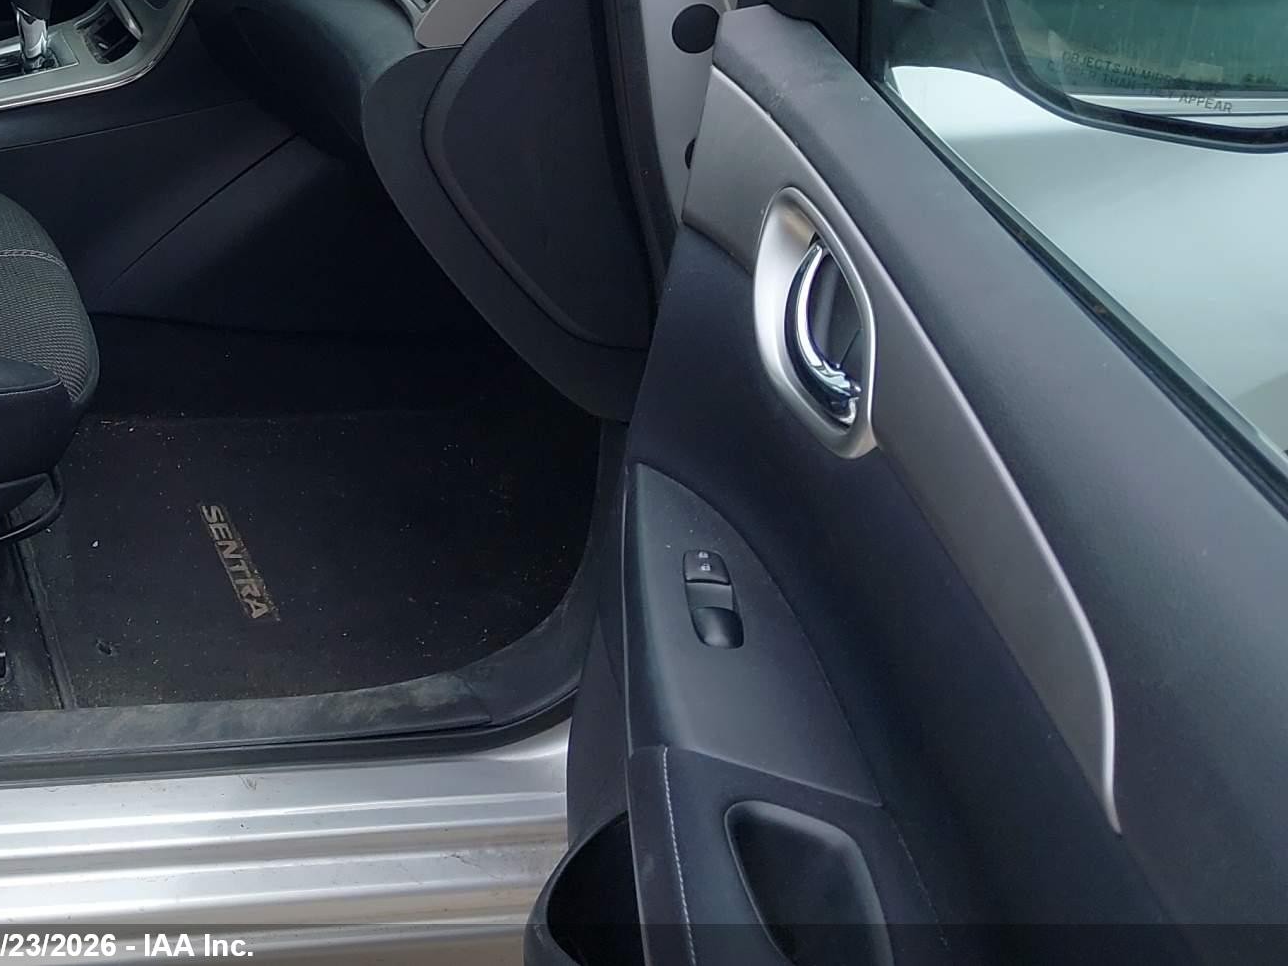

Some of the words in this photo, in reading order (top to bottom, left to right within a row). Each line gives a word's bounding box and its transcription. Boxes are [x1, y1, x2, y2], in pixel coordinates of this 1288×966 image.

[1062, 51, 1121, 74] OBJECTS
[1123, 66, 1137, 78] IN
[1178, 94, 1233, 113] APPEAR
[200, 505, 269, 619] SENTRA
